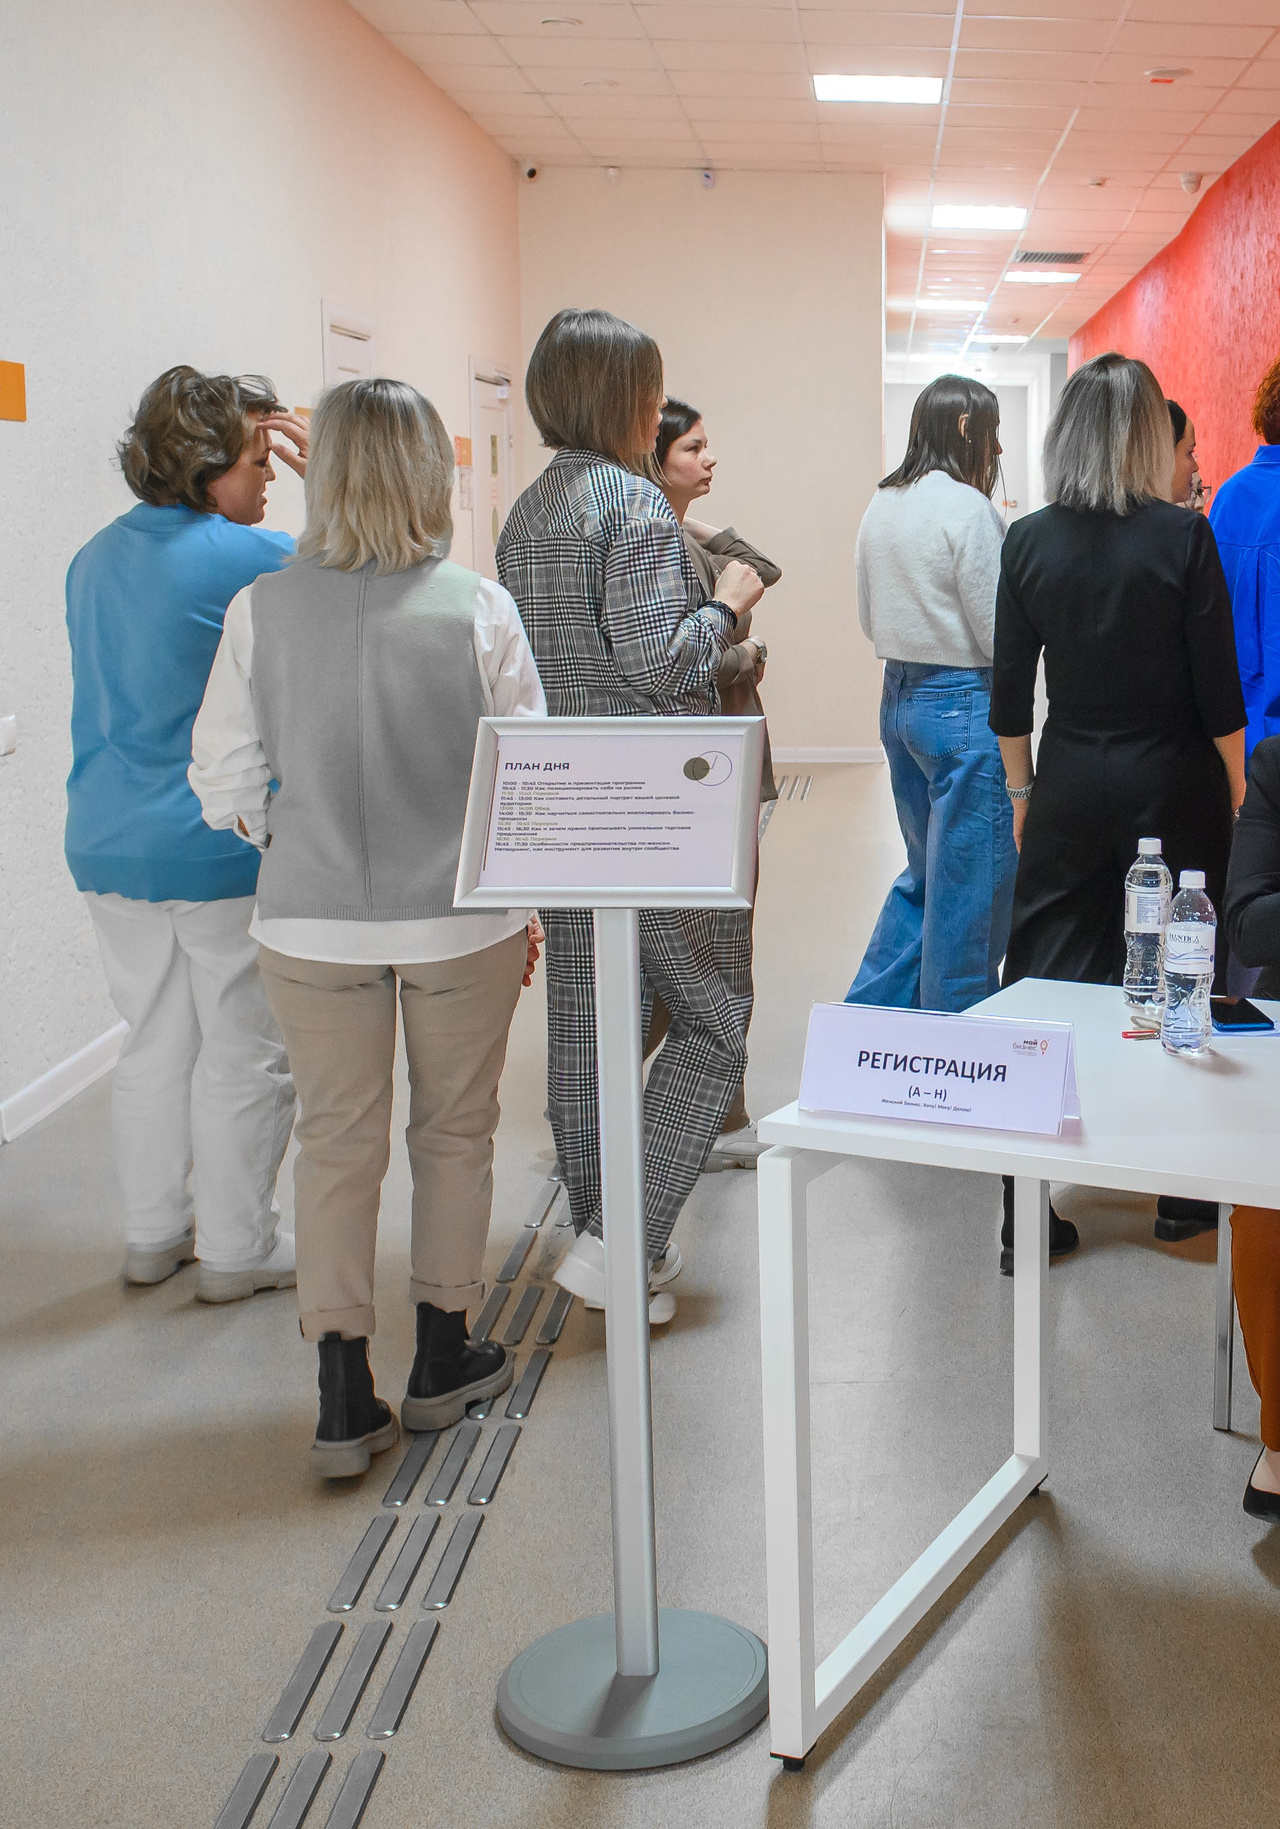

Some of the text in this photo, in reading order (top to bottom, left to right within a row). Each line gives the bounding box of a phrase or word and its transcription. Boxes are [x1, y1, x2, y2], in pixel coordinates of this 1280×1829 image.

[504, 762, 570, 772] ПЛАН ДНЯ
[1012, 1042, 1037, 1051] бизнес
[857, 1050, 1007, 1083] РЕГИСТРАЦИЯ
[908, 1085, 921, 1099] (А
[934, 1087, 947, 1102] Н)
